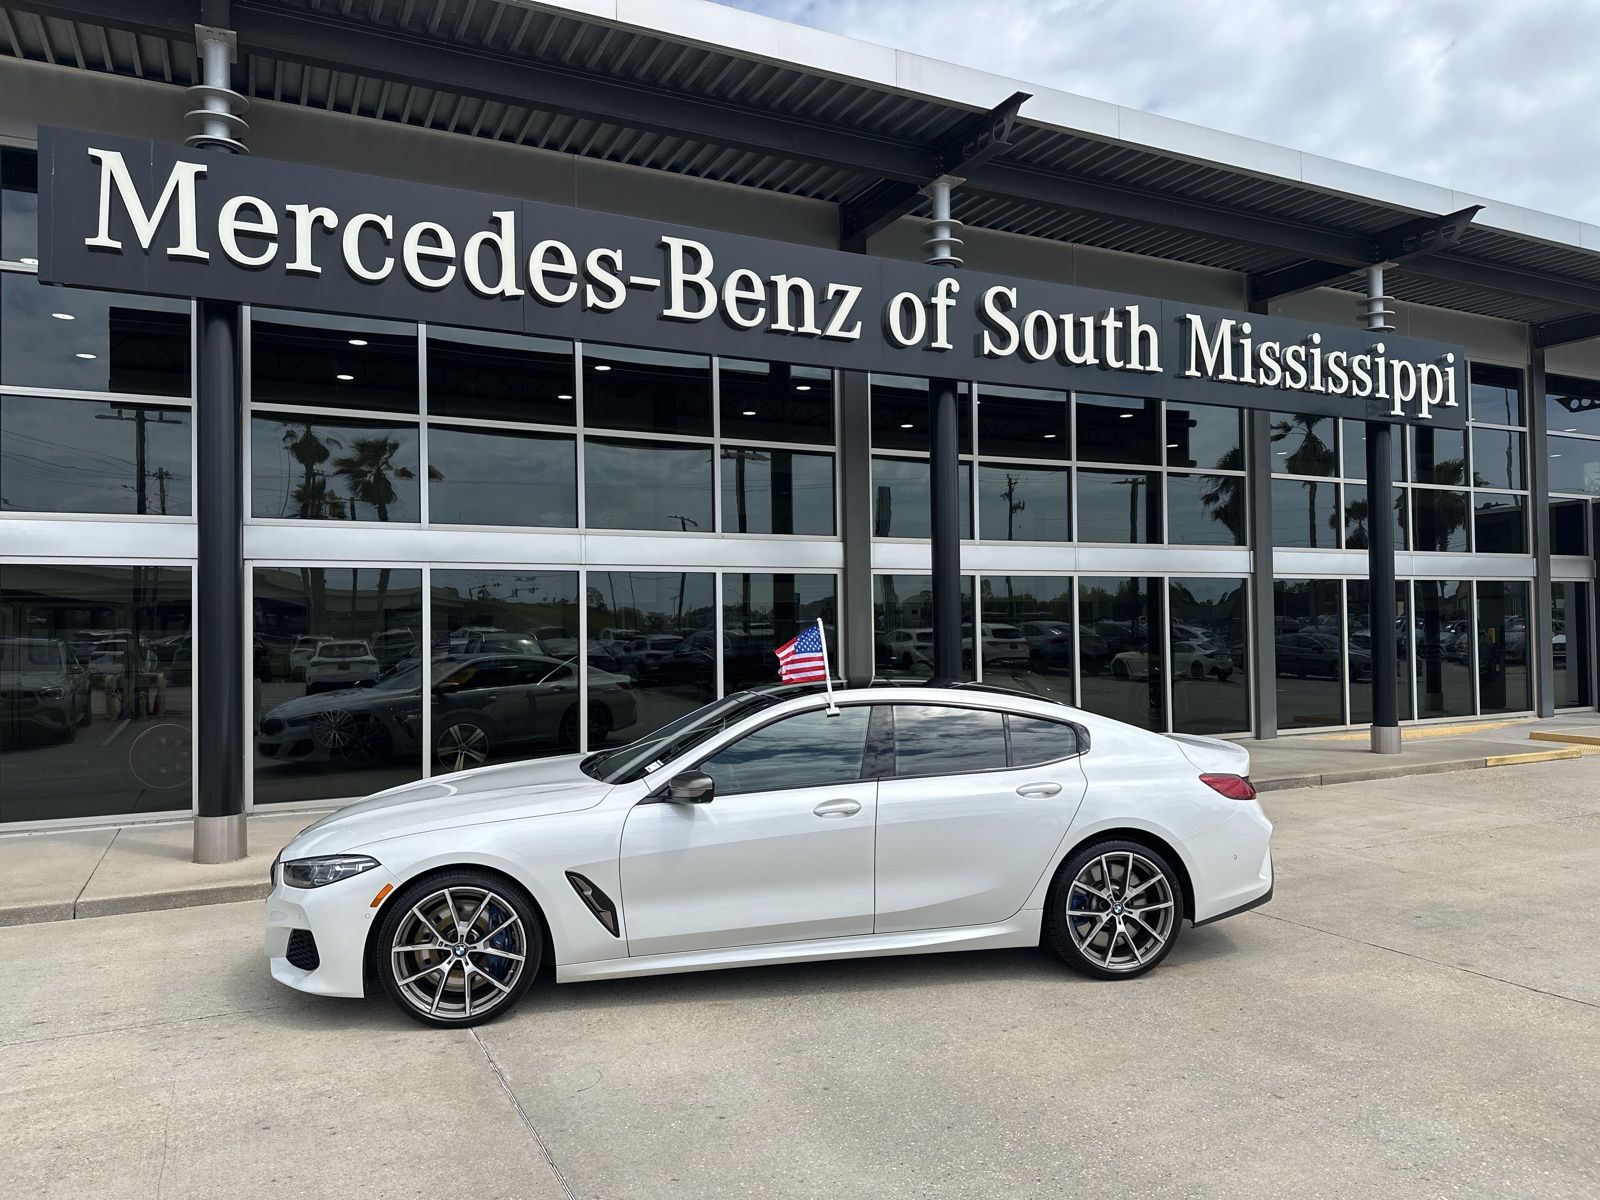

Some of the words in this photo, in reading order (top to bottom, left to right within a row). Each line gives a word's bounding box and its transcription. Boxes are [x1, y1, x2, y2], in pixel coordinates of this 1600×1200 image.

[84, 147, 863, 340] Mercedes-Benz
[889, 277, 960, 350] of
[983, 285, 1164, 373] South
[1185, 313, 1459, 419] Mississippi
